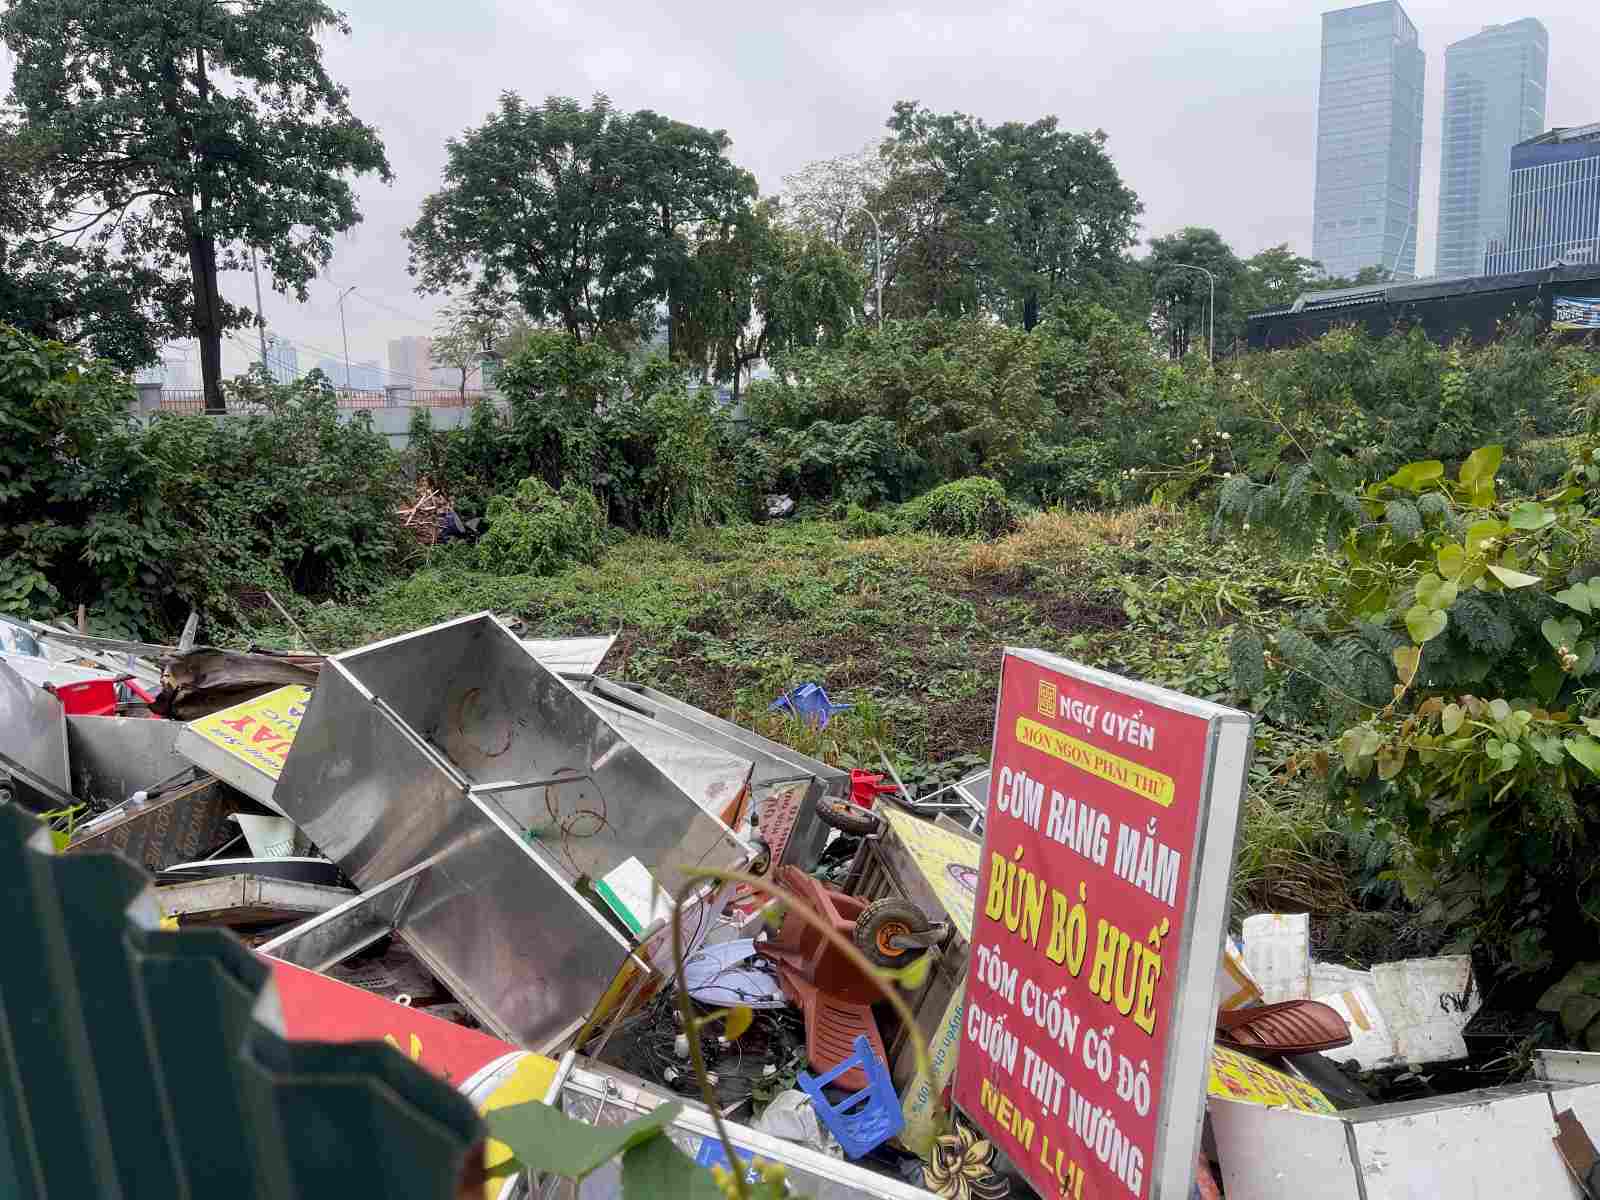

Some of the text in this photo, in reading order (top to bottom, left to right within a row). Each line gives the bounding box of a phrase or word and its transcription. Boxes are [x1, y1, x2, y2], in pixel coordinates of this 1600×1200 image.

[1059, 694, 1155, 750] NGỰ UYỂN
[996, 766, 1044, 832] CƠM
[1046, 789, 1111, 867] RANG
[1114, 816, 1181, 908] MẮM
[985, 844, 1047, 950] BÚN
[1046, 880, 1087, 977] BÒ
[1089, 917, 1170, 1035] HUẾ
[967, 1004, 1144, 1198] CUỐN THỊT NƯỚNG
[977, 944, 1020, 1005] TÔM
[1021, 979, 1079, 1054] CUỐN
[1083, 1025, 1115, 1082] CỐ
[1117, 1054, 1150, 1117] ĐÔ
[981, 1078, 1035, 1152] NEM
[1040, 1135, 1086, 1199] LỤI
